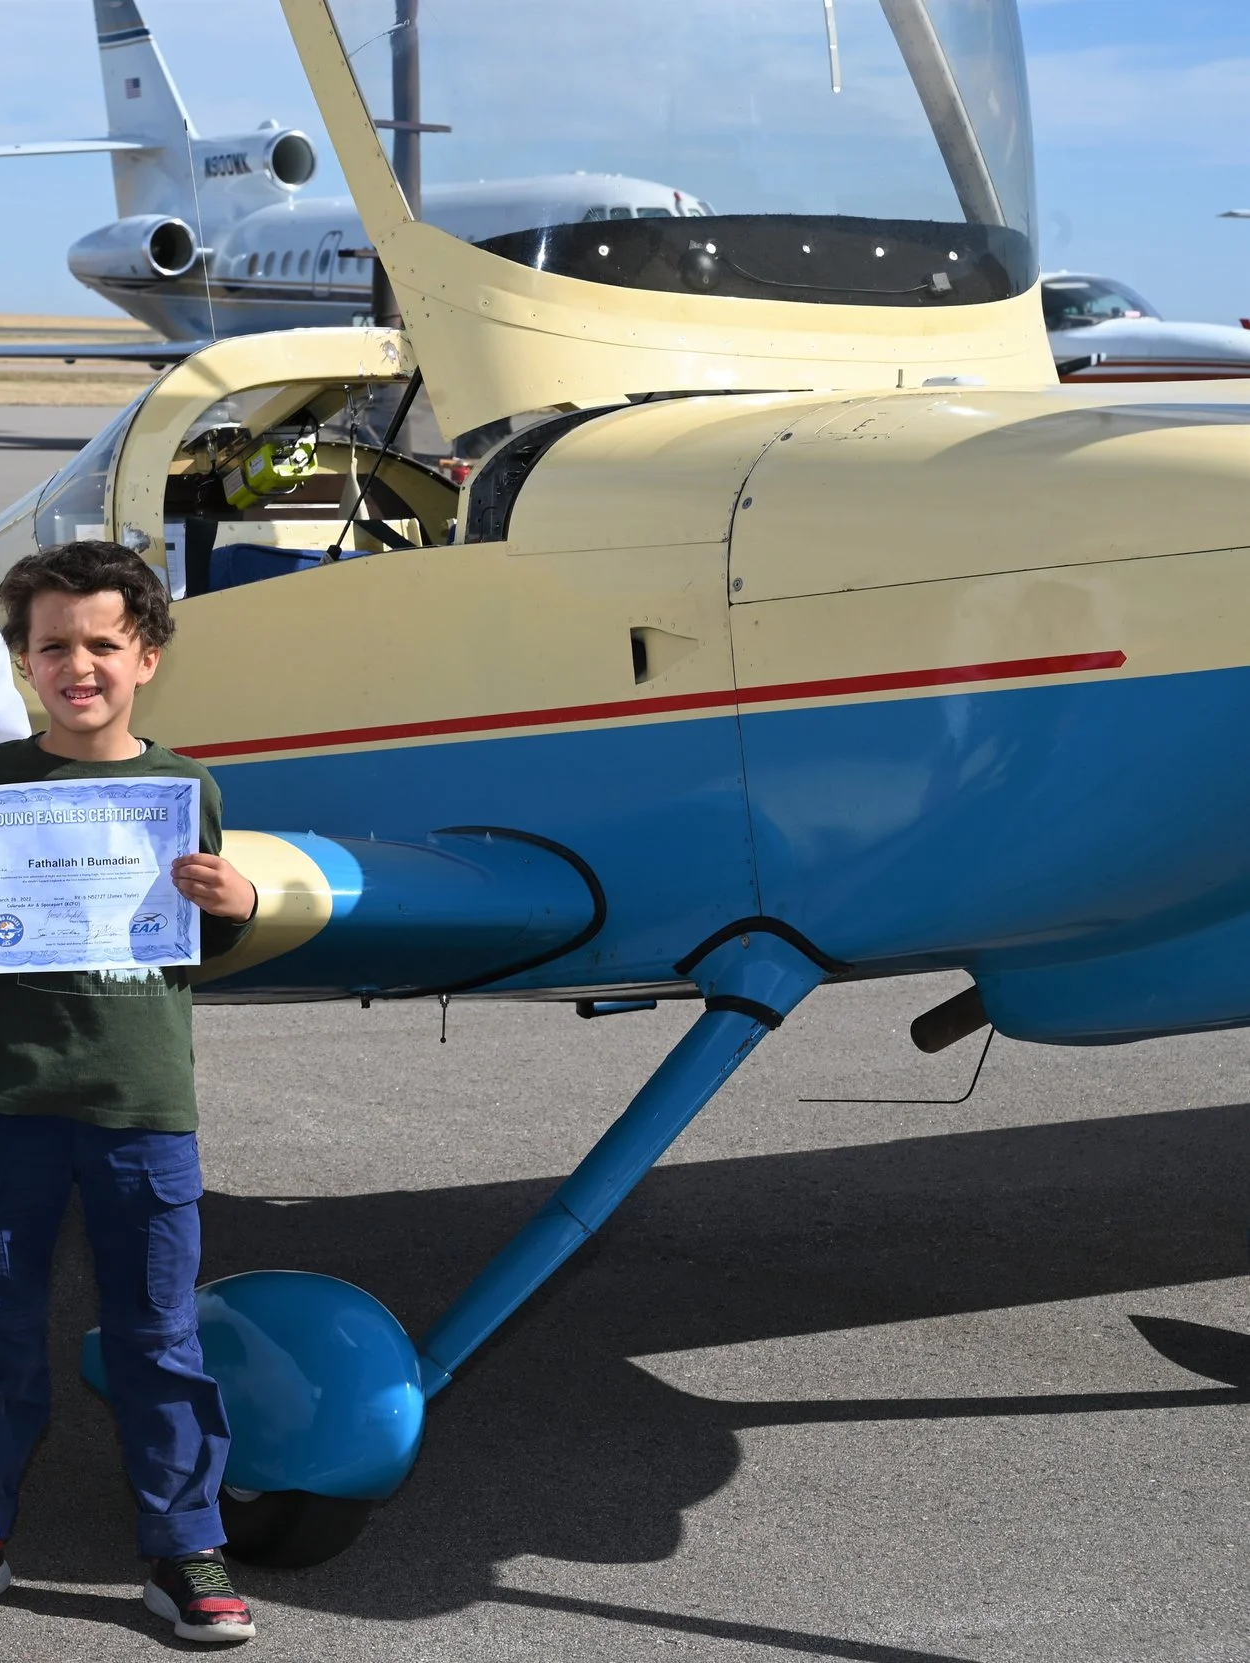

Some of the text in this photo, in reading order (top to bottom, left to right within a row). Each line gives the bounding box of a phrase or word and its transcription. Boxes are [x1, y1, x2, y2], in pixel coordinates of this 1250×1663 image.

[36, 809, 86, 825] EAGLES
[88, 807, 168, 822] CERTIFICATE
[28, 858, 78, 869] Fathallah
[88, 856, 140, 867] Bumadian
[130, 923, 160, 933] EAA
